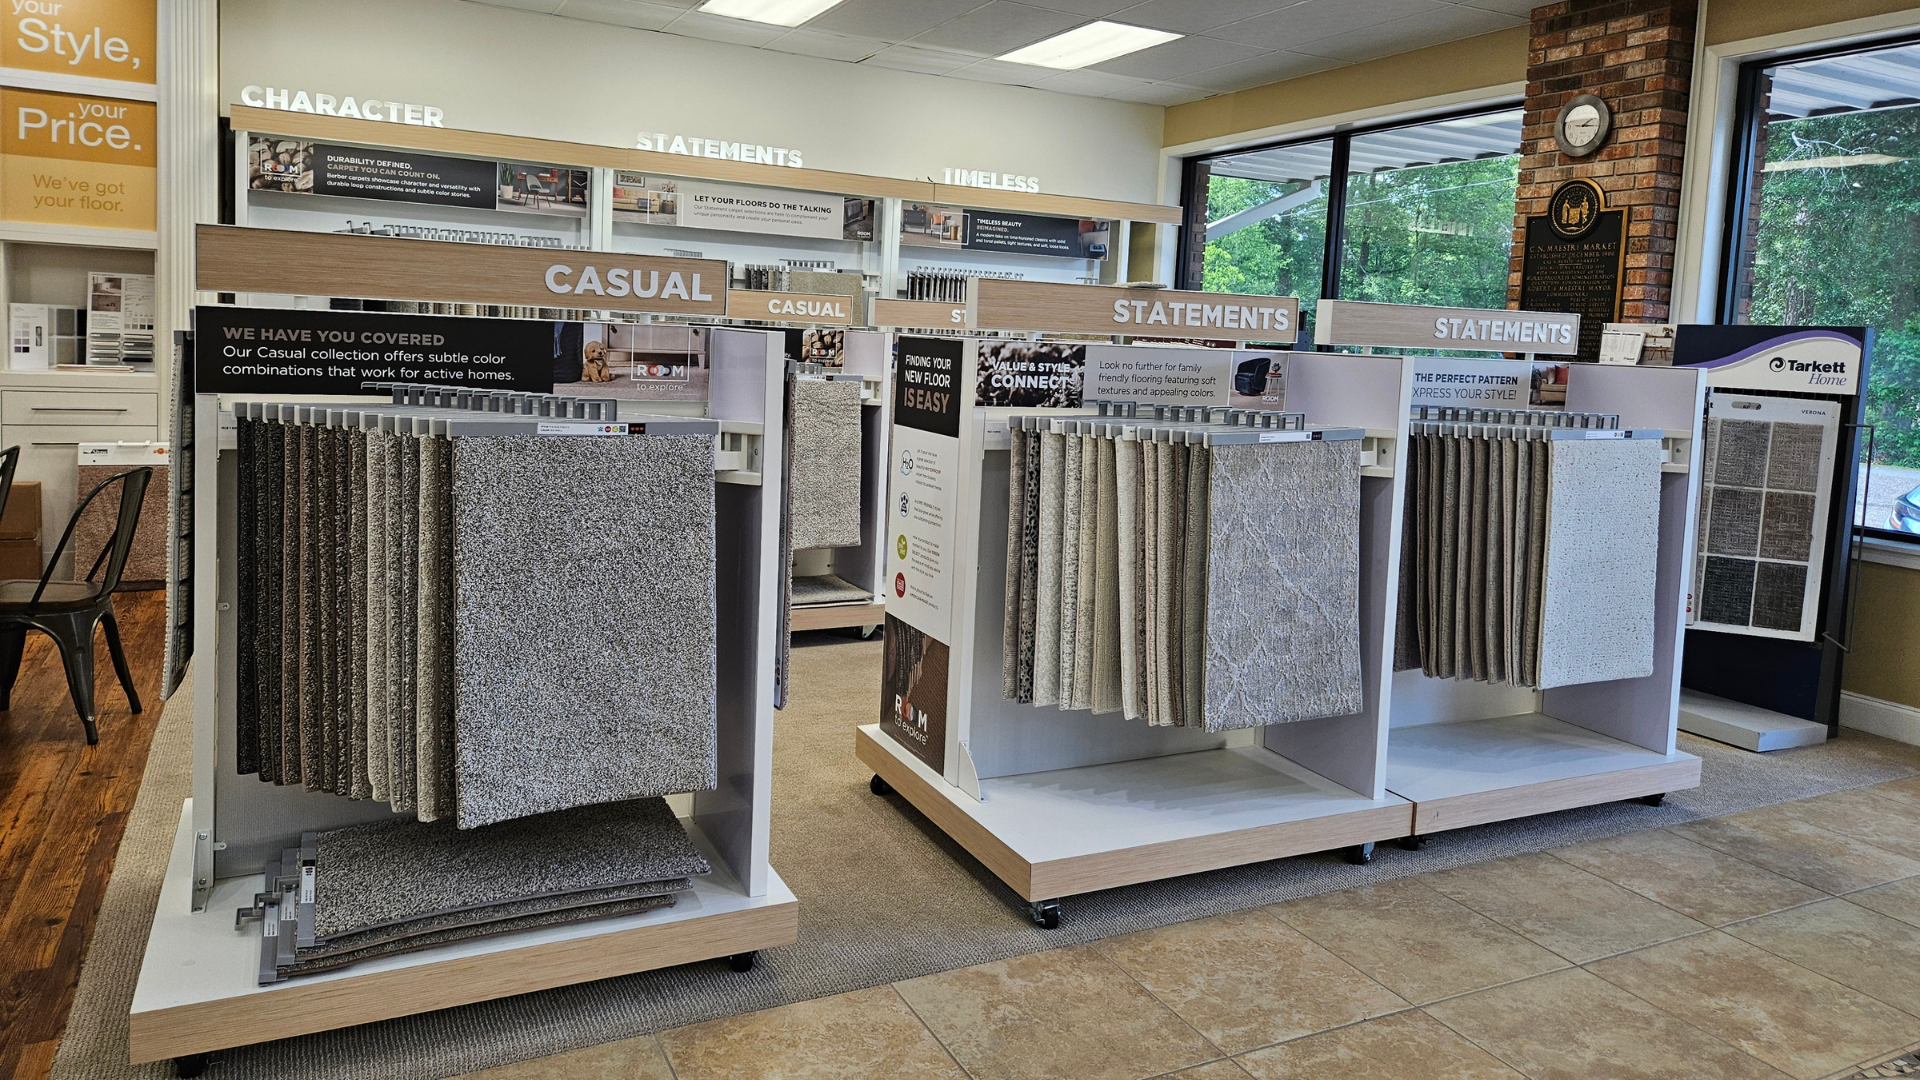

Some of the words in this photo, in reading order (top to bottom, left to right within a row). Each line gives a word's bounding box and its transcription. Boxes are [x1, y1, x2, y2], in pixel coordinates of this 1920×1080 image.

[11, 0, 62, 16] your
[17, 17, 141, 70] Style,
[78, 102, 128, 119] your
[241, 84, 444, 129] CHARACTER
[18, 106, 142, 151] Price.
[635, 131, 804, 169] STATEMENTS
[326, 155, 375, 166] DURABILITY
[326, 163, 359, 172] CARPET
[360, 166, 378, 174] YOU
[379, 168, 397, 176] CAN
[397, 170, 426, 179] COUNT
[32, 173, 90, 192] We've
[95, 181, 126, 197] got
[326, 172, 348, 180] Berber
[348, 174, 371, 183] carpets
[371, 177, 400, 185] showcase
[400, 179, 428, 187] character
[440, 183, 468, 192] versatility
[941, 166, 1040, 194] TIMELESS
[326, 180, 350, 188] durable
[350, 181, 365, 190] loop
[365, 183, 404, 193] constructions
[404, 186, 416, 194] and
[416, 187, 435, 195] subtle
[435, 189, 450, 197] color
[450, 191, 472, 199] stories.
[33, 195, 75, 209] your
[79, 196, 125, 212] floor.
[694, 194, 709, 202] LET
[711, 196, 734, 205] YOUR
[735, 198, 768, 208] FLOORS
[782, 203, 797, 211] THE
[798, 204, 832, 214] TALKING
[976, 218, 1001, 226] TIMELESS
[1001, 220, 1022, 228] BEAUTY
[1582, 242, 1618, 251] MARKET
[544, 264, 713, 302] CASUAL
[768, 298, 845, 319] CASUAL
[1113, 299, 1289, 331] STATEMENTS
[222, 326, 255, 340] WE
[260, 328, 312, 342] HAVE
[316, 330, 356, 343] YOU
[360, 331, 445, 346] COVERED
[1434, 317, 1572, 345] STATEMENTS
[222, 345, 253, 358] Our
[256, 346, 306, 359] Casual
[310, 348, 379, 361] collection
[383, 350, 424, 363] offers
[428, 351, 469, 364] subtle
[472, 353, 507, 365] color
[905, 354, 931, 368] FINDING
[932, 357, 952, 371] YOUR
[222, 363, 323, 377] combinations
[328, 365, 357, 377] that
[360, 367, 396, 378] work
[400, 366, 420, 378] for
[423, 367, 464, 380] active
[468, 368, 515, 381] homes.
[992, 361, 1027, 372] VALUE
[1028, 362, 1036, 372] &
[1037, 362, 1071, 373] STYLE
[1099, 361, 1120, 370] Look
[1135, 362, 1163, 371] further
[1165, 362, 1177, 371] for
[1178, 362, 1202, 373] family
[1787, 359, 1846, 374] Tarkett
[904, 369, 923, 384] NEW
[923, 371, 951, 388] FLOOR
[990, 374, 1070, 389] CONNECT
[1098, 372, 1130, 384] friendly
[1131, 374, 1163, 386] flooring
[1164, 374, 1200, 386] featuring
[1201, 375, 1217, 385] soft
[1415, 372, 1434, 383] THE
[1435, 373, 1476, 384] PERFECT
[1478, 375, 1518, 385] PATTERN
[1807, 373, 1847, 386] Home
[636, 383, 647, 391] to
[649, 383, 684, 392] explore
[1097, 386, 1131, 396] textures
[1132, 386, 1148, 396] and
[1149, 387, 1189, 398] appealing
[1190, 388, 1216, 398] colors.
[1453, 387, 1483, 400] YOUR
[1484, 389, 1517, 400] STYLE!
[903, 387, 915, 408] IS
[916, 389, 950, 414] EASY
[894, 713, 902, 727] to
